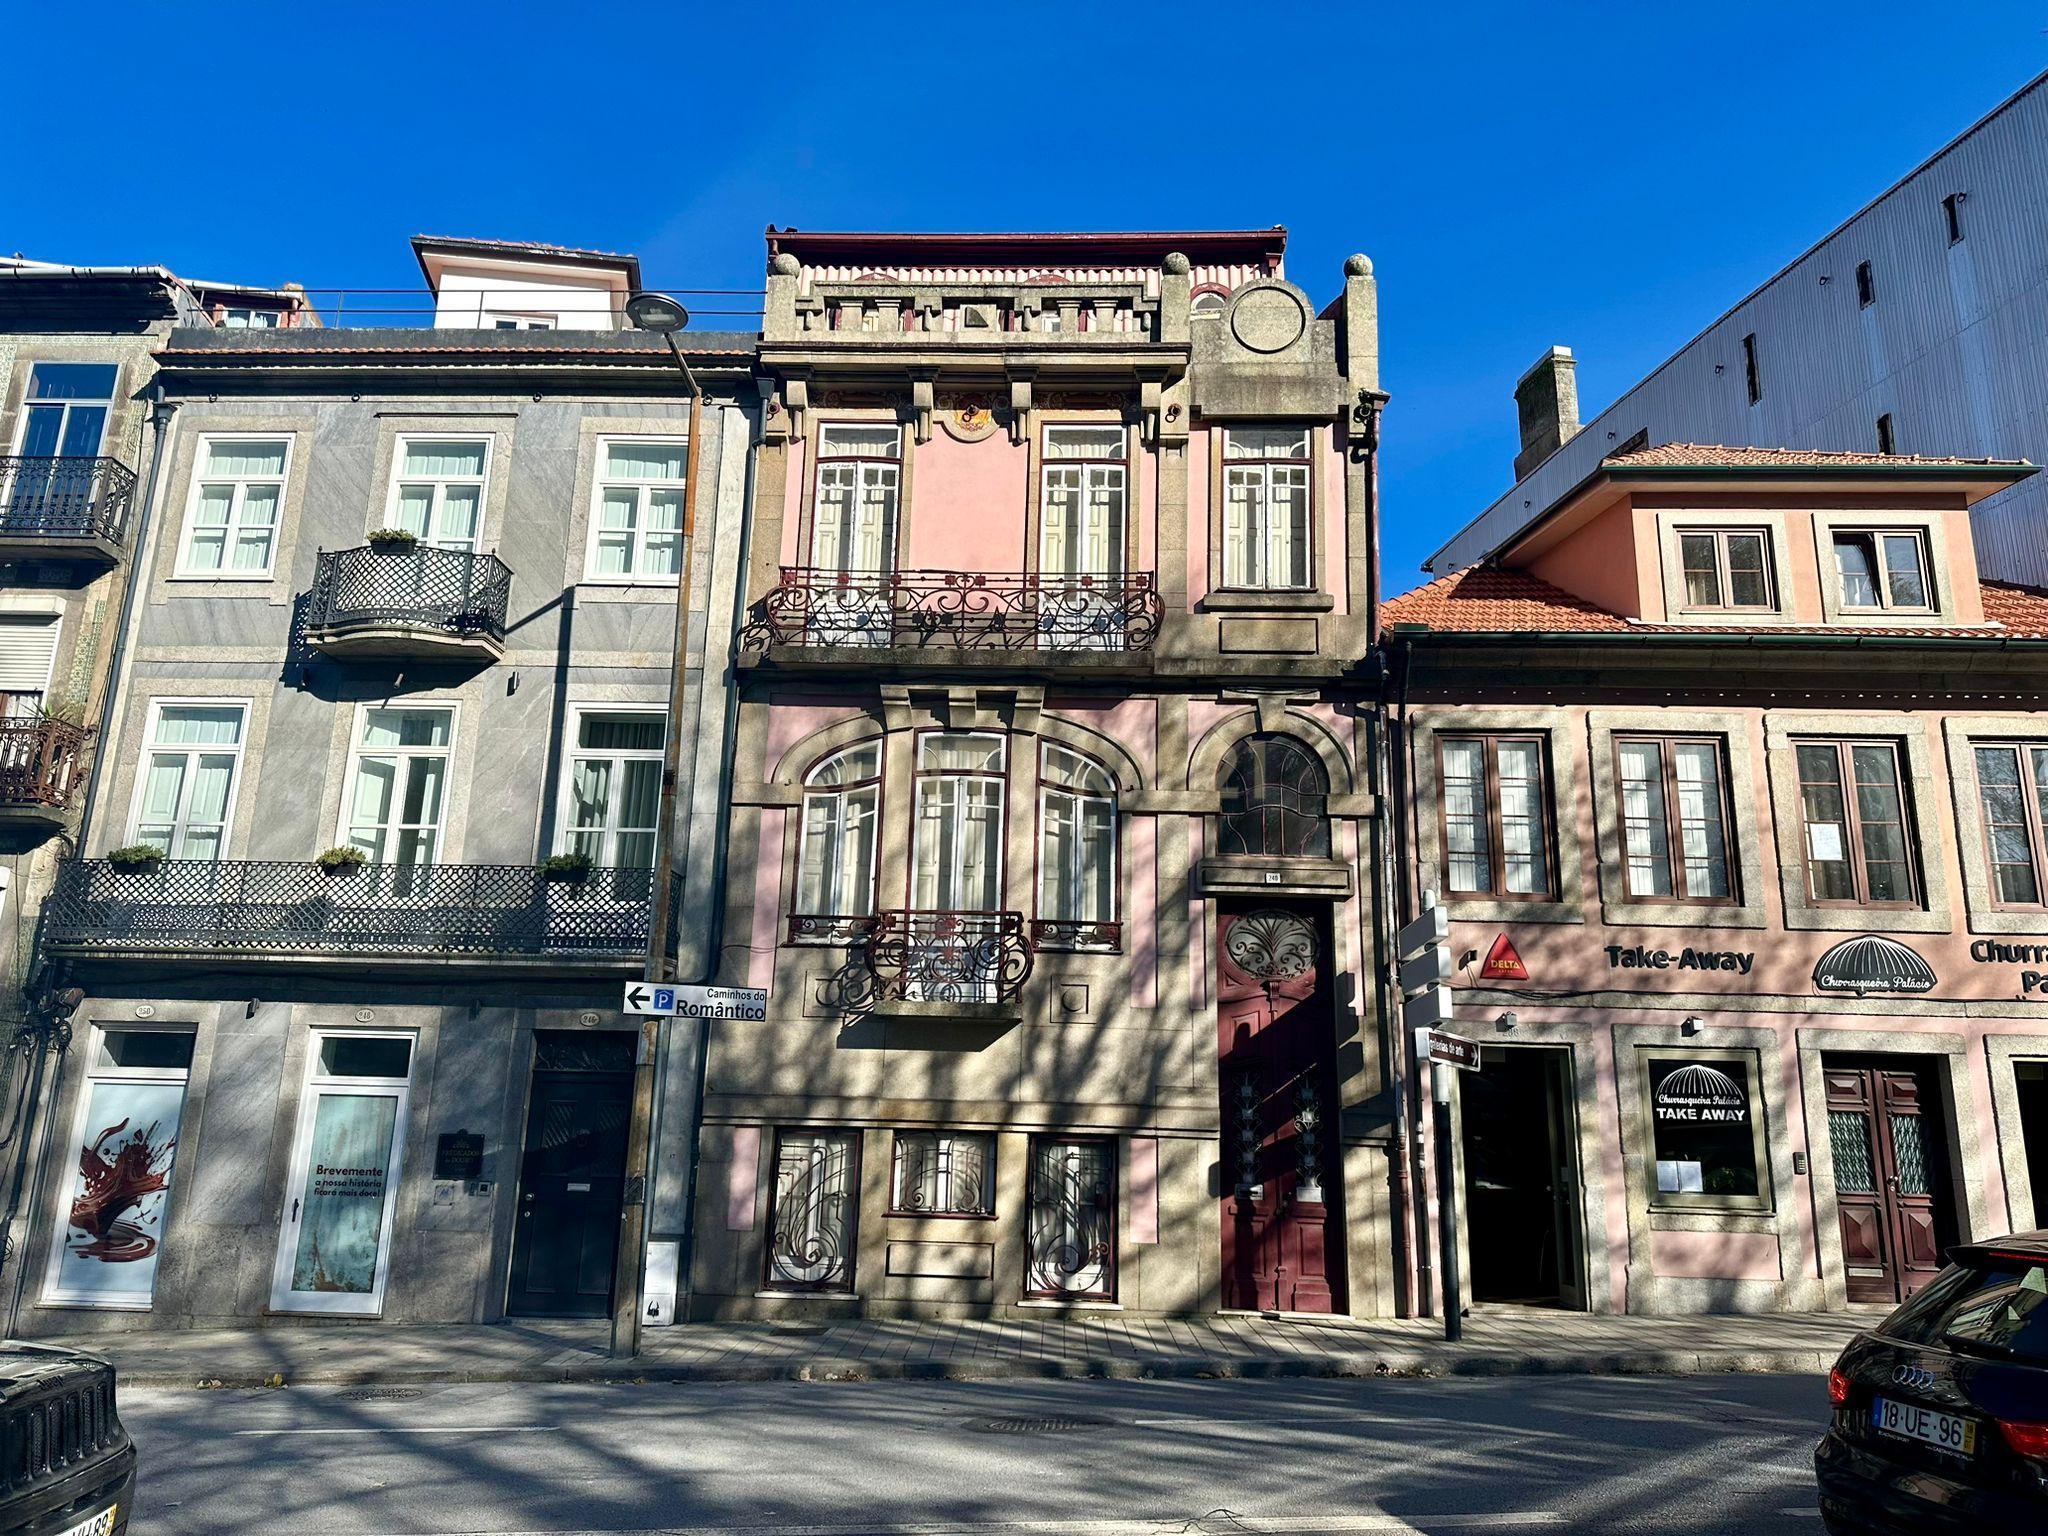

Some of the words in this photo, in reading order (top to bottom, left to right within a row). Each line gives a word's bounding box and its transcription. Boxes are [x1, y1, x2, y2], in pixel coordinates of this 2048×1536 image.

[1970, 939, 2048, 964] Churr
[1490, 960, 1521, 969] DELTA
[1604, 945, 1755, 975] Take-Away
[1821, 975, 1890, 991] Churrasqueira
[1892, 975, 1931, 989] Palácio
[706, 988, 752, 1000] Caminhos
[753, 991, 765, 1001] do
[676, 1000, 765, 1020] Romântico
[1659, 1094, 1711, 1106] Churrasqueira
[1713, 1095, 1741, 1105] Palácio
[1656, 1108, 1697, 1120] TAKE
[1701, 1109, 1745, 1121] AWAY
[316, 1164, 383, 1176] Brevemente
[349, 1179, 382, 1187] história
[314, 1187, 337, 1196] ficará
[359, 1189, 380, 1197] doce!
